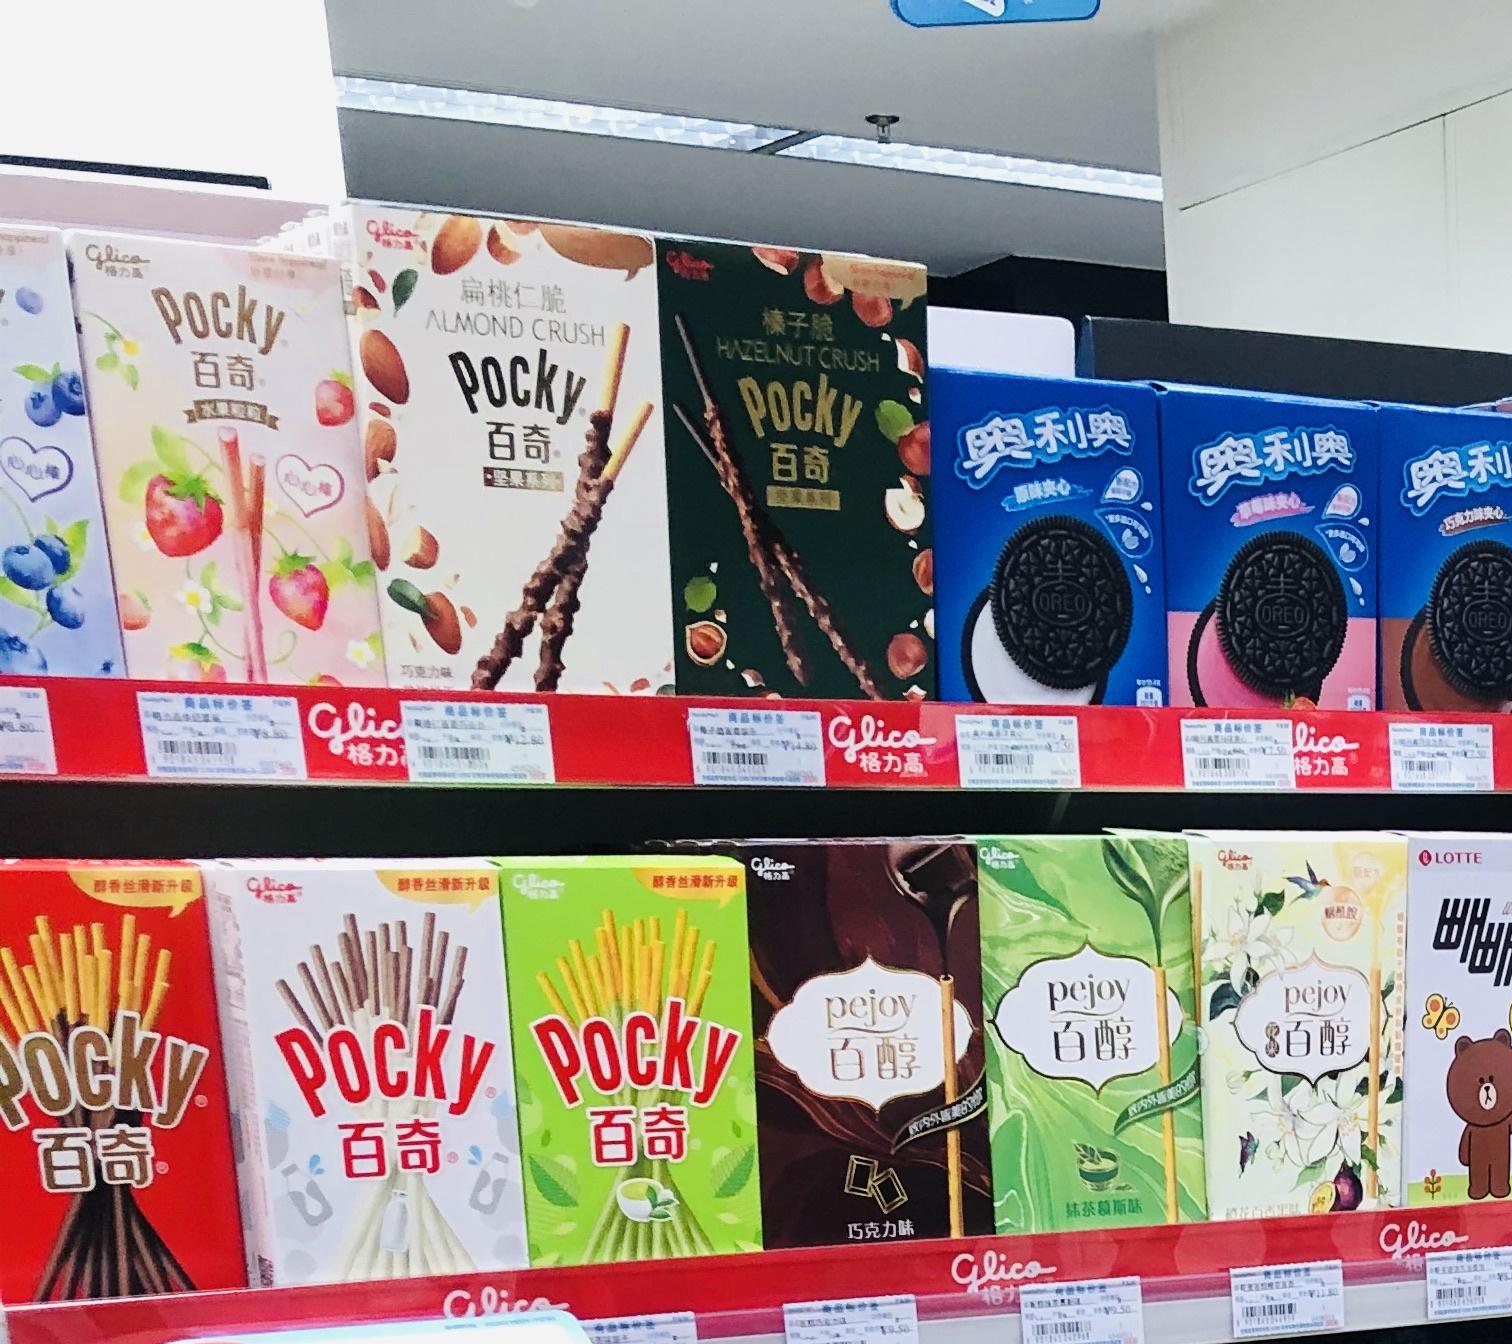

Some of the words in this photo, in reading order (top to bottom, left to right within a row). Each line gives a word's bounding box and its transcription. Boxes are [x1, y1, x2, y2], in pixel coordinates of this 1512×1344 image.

[461, 277, 567, 313] 扁桃仁脆
[151, 285, 287, 357] Pocky
[425, 310, 524, 340] ALMOND
[531, 318, 606, 347] CRUSH
[761, 308, 835, 341] 榛子脆
[192, 354, 257, 392] 百奇
[716, 336, 819, 369] HAZELNUT
[821, 346, 880, 372] CRUSH
[448, 348, 587, 425] Pocky
[737, 374, 863, 448] Pocky
[485, 422, 552, 464] 百奇
[771, 444, 831, 484] 百奇
[963, 408, 1134, 478] 奥利奥
[1199, 430, 1355, 493] 奥利奥
[828, 715, 936, 752] Glico
[860, 752, 924, 774] 格力高
[1435, 851, 1483, 865] LOTTE
[94, 876, 193, 896] 醇香丝滑新升级
[397, 875, 491, 893] 醇香丝滑新升级
[825, 989, 918, 1033] pejoy
[1047, 974, 1132, 1013] pejoy
[1283, 980, 1352, 1014] pejoy
[274, 1005, 496, 1118] Pocky
[530, 996, 742, 1111] Pocky
[830, 1036, 921, 1082] 百醇
[1051, 1019, 1137, 1062] 百醇
[0, 1011, 209, 1131] Pocky
[337, 1119, 442, 1180] 百奇
[587, 1106, 689, 1168] 百奇
[33, 1125, 155, 1193] 百奇
[848, 1218, 915, 1240] 巧克力味
